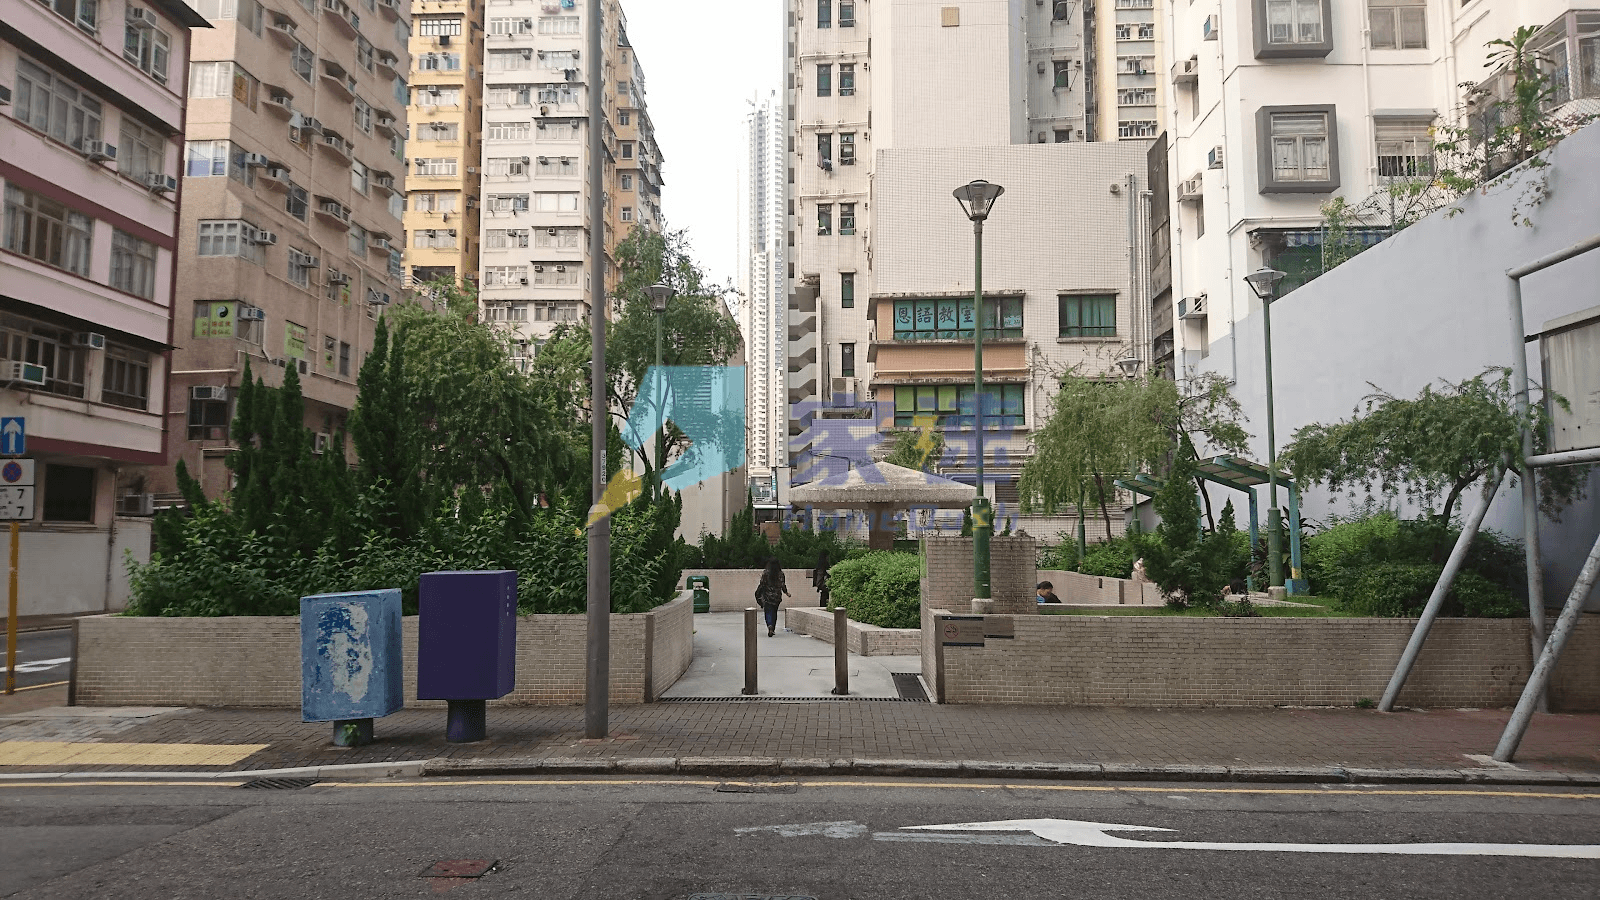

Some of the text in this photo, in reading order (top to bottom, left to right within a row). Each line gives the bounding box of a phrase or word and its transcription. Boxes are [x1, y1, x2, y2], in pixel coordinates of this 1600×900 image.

[896, 306, 975, 324] 恩語教室
[17, 488, 24, 499] 7
[16, 505, 24, 517] 7
